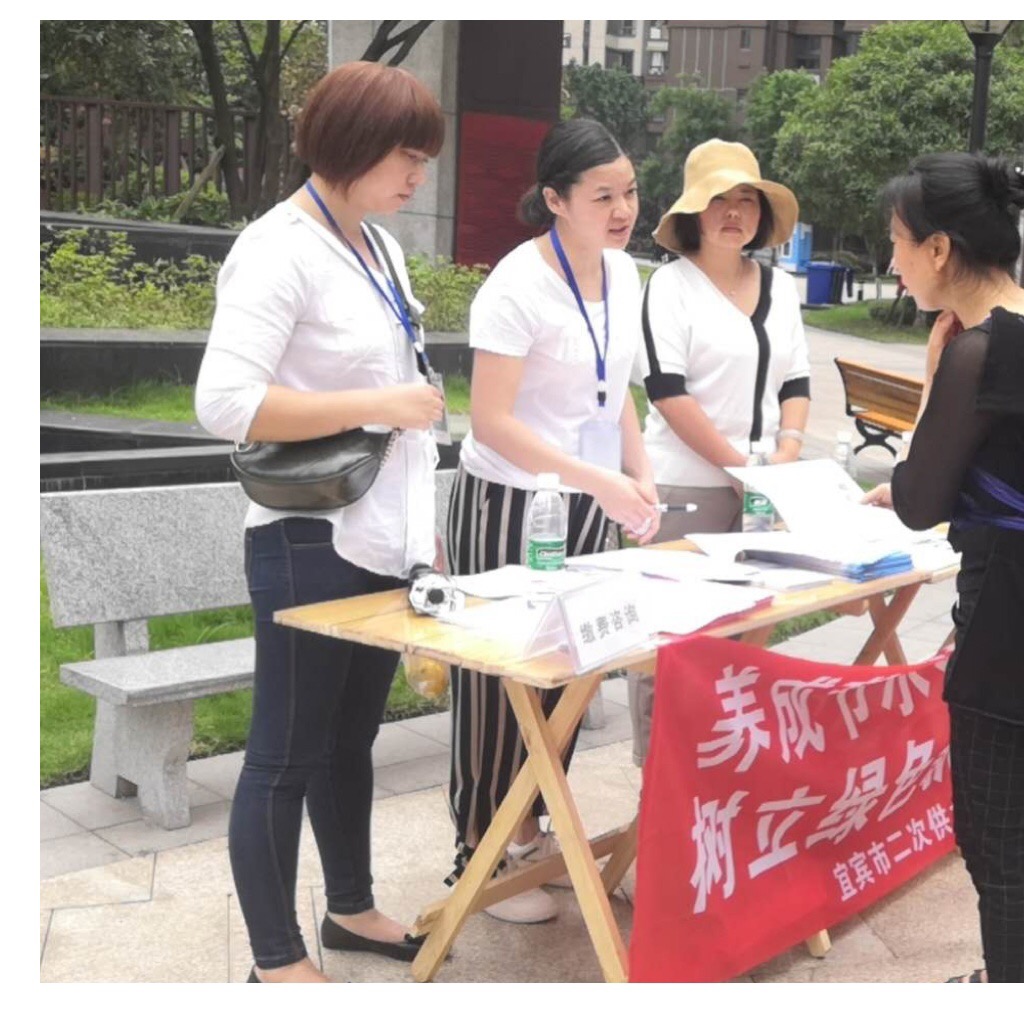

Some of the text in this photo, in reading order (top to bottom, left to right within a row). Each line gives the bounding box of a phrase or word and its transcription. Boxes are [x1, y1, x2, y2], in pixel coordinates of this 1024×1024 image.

[580, 603, 639, 644] 缴费咨询
[833, 803, 953, 902] 宜宾市二次供
